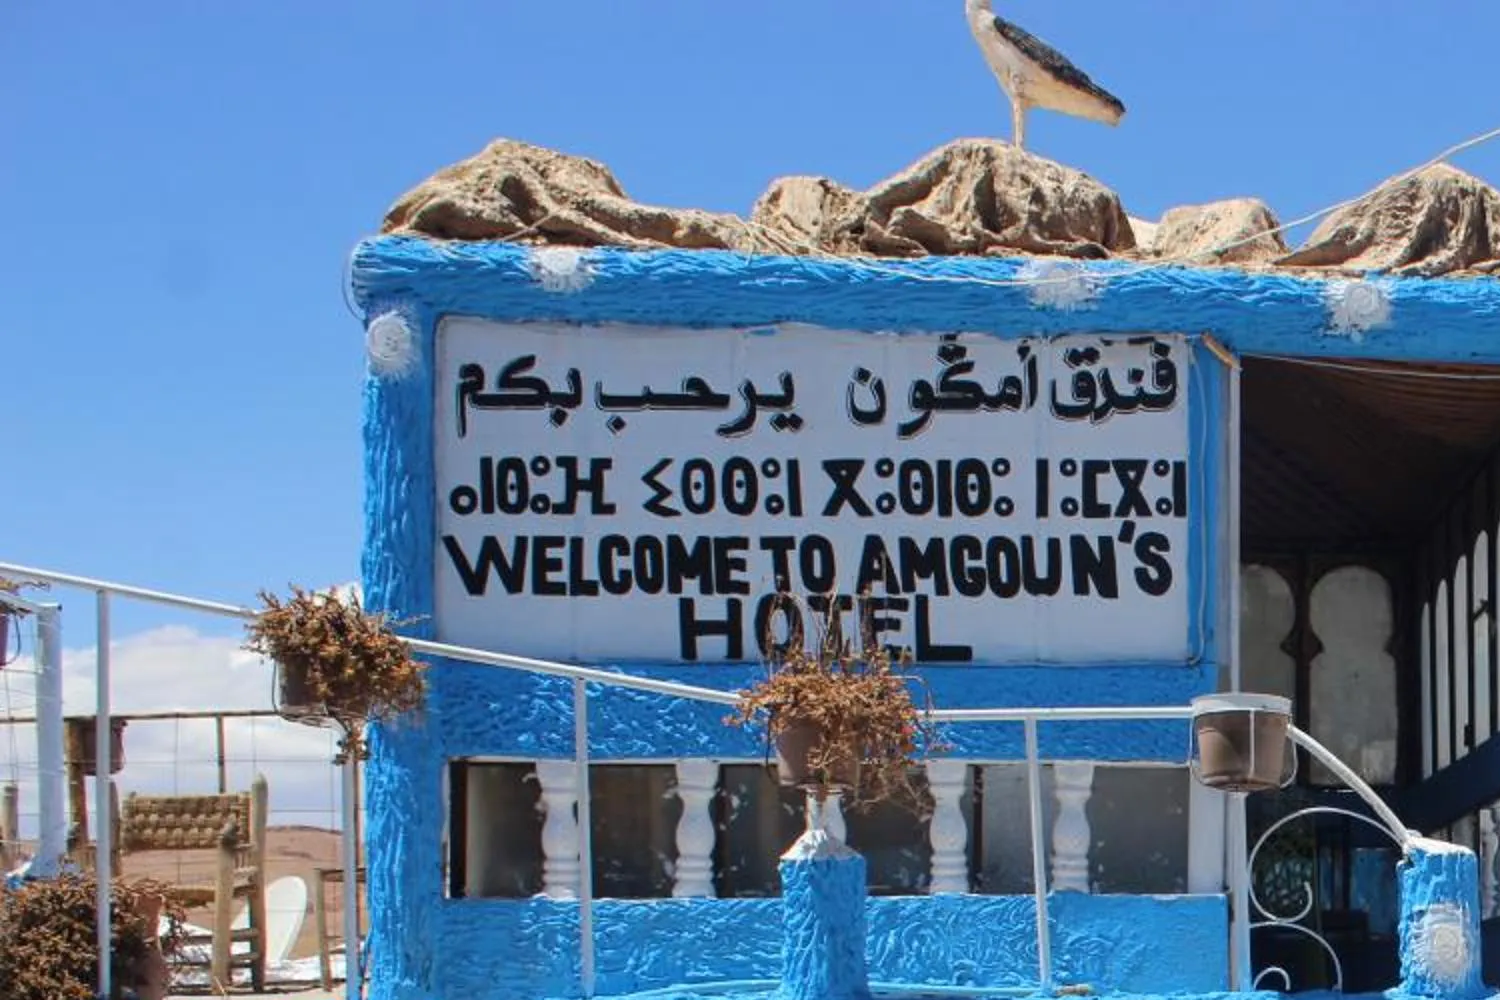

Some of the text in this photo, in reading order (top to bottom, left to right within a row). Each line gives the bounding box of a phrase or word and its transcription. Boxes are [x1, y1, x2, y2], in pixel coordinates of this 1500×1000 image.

[456, 353, 583, 438] بكم
[594, 369, 804, 438] يرحب
[1050, 340, 1178, 424] فندق
[442, 520, 1174, 599] WELCOME TO AMGOUN'S
[678, 592, 974, 662] HOTEL
